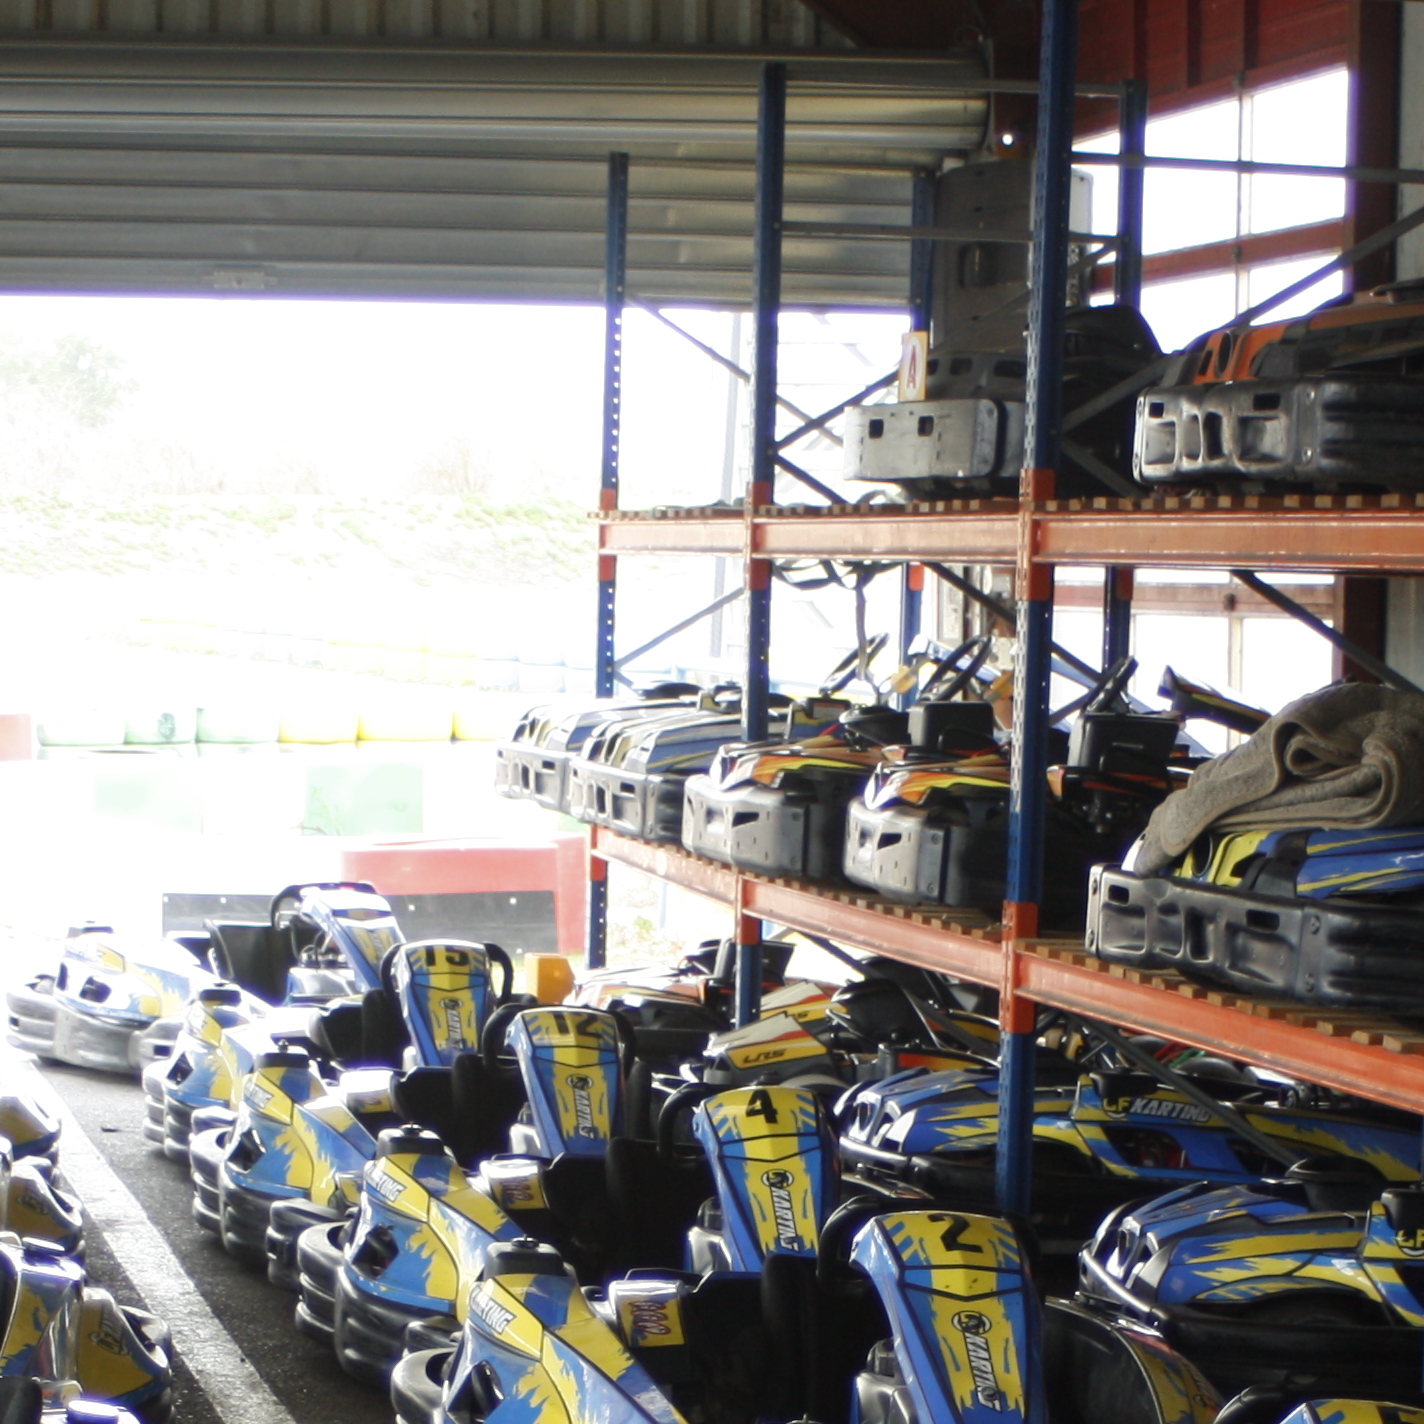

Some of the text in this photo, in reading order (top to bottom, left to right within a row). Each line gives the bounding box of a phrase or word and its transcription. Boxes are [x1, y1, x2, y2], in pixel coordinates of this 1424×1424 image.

[743, 1048, 788, 1065] LRS
[745, 1089, 779, 1124] 4
[927, 1212, 985, 1254] 2
